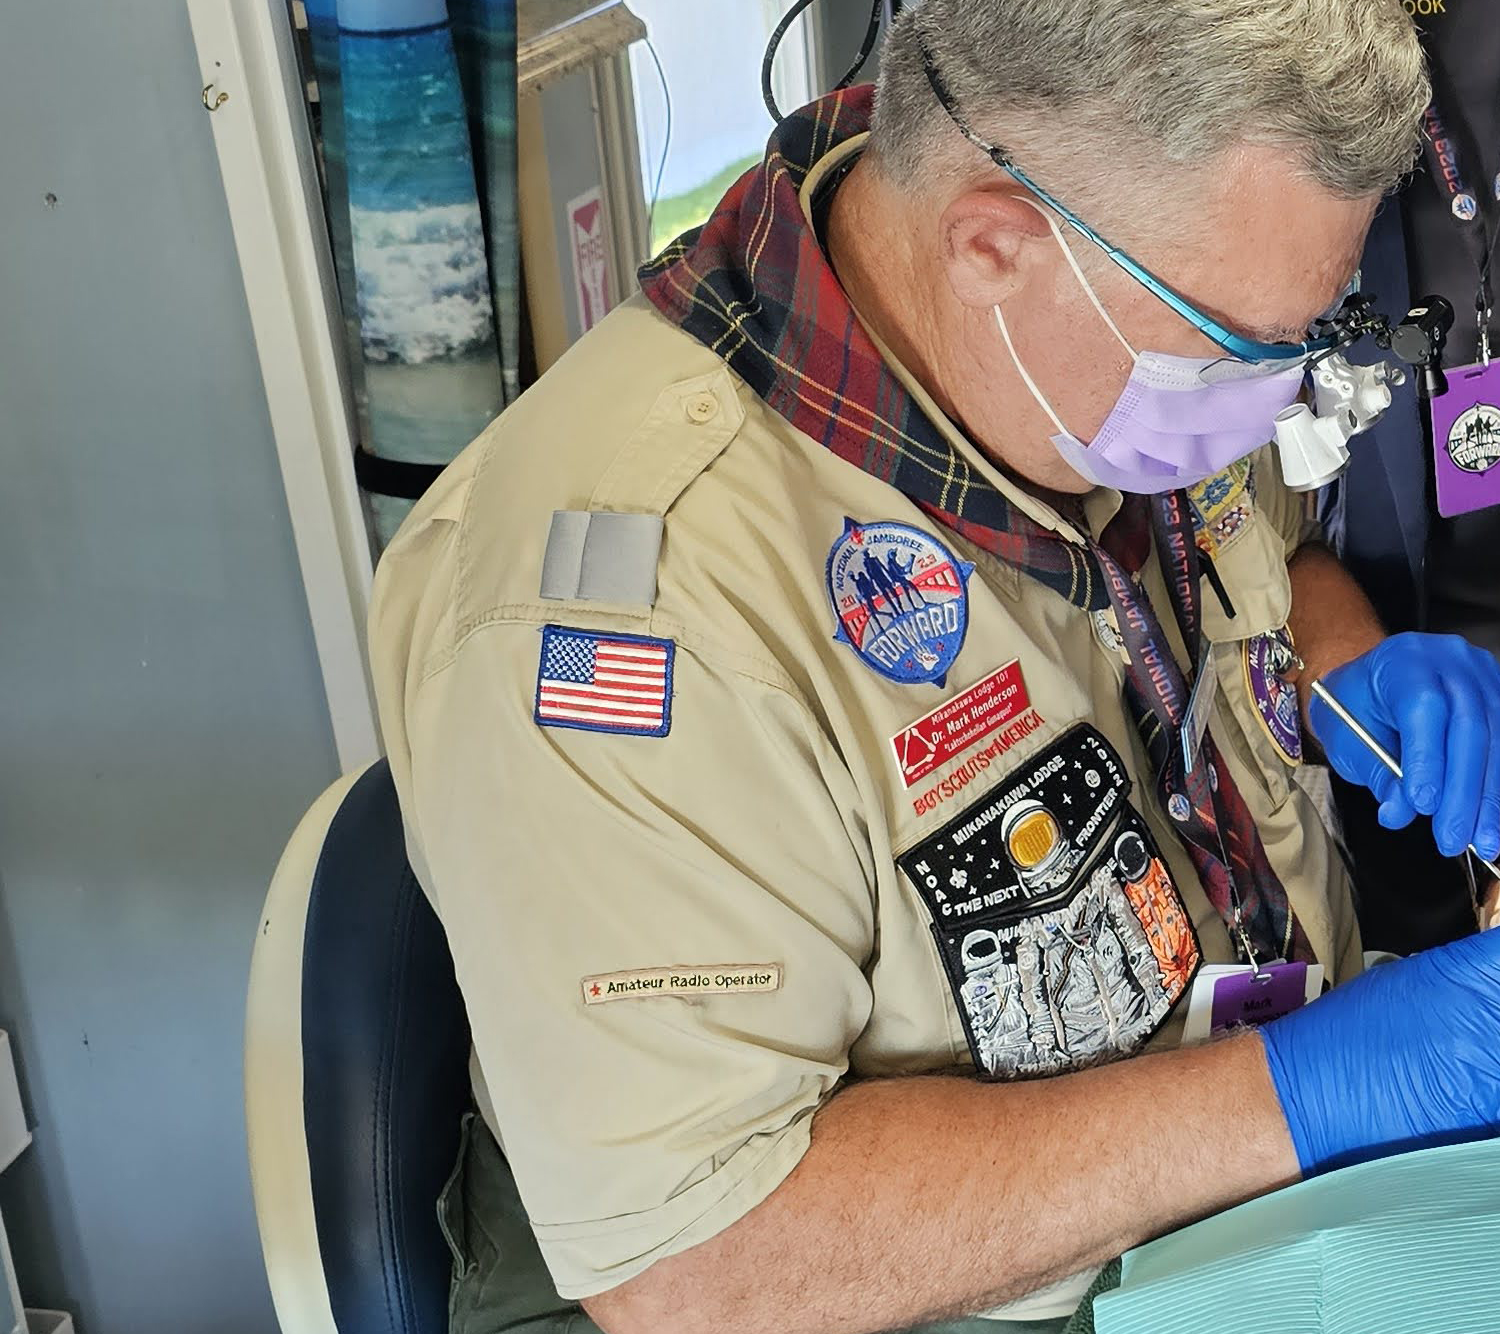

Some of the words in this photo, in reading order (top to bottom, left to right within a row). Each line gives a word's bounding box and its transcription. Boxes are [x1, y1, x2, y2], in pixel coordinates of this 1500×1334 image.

[1434, 137, 1464, 194] 2023
[837, 545, 858, 591] NATIONAL
[866, 533, 926, 553] JAMBOREE
[840, 594, 857, 609] 20
[868, 602, 960, 669] FORWARD
[931, 695, 973, 726] Mikanakawa
[973, 681, 995, 699] Lodge
[995, 670, 1009, 685] 101
[931, 731, 946, 745] Dr.
[946, 712, 970, 735] Mark
[971, 684, 1018, 720] Henderson
[913, 785, 944, 817] BOY
[944, 751, 990, 797] SCOUTS
[995, 709, 1045, 756] AMERICA
[1086, 737, 1124, 787] 2022
[951, 782, 1031, 846] MIKANAKAWA
[1027, 754, 1066, 789] LODGE
[953, 896, 984, 917] THE
[983, 884, 1021, 909] NEXT
[1075, 787, 1118, 847] FRONTIER
[915, 860, 952, 916] NOAC
[607, 978, 664, 994] Amateur
[670, 974, 710, 988] Radio
[714, 973, 771, 989] Operator
